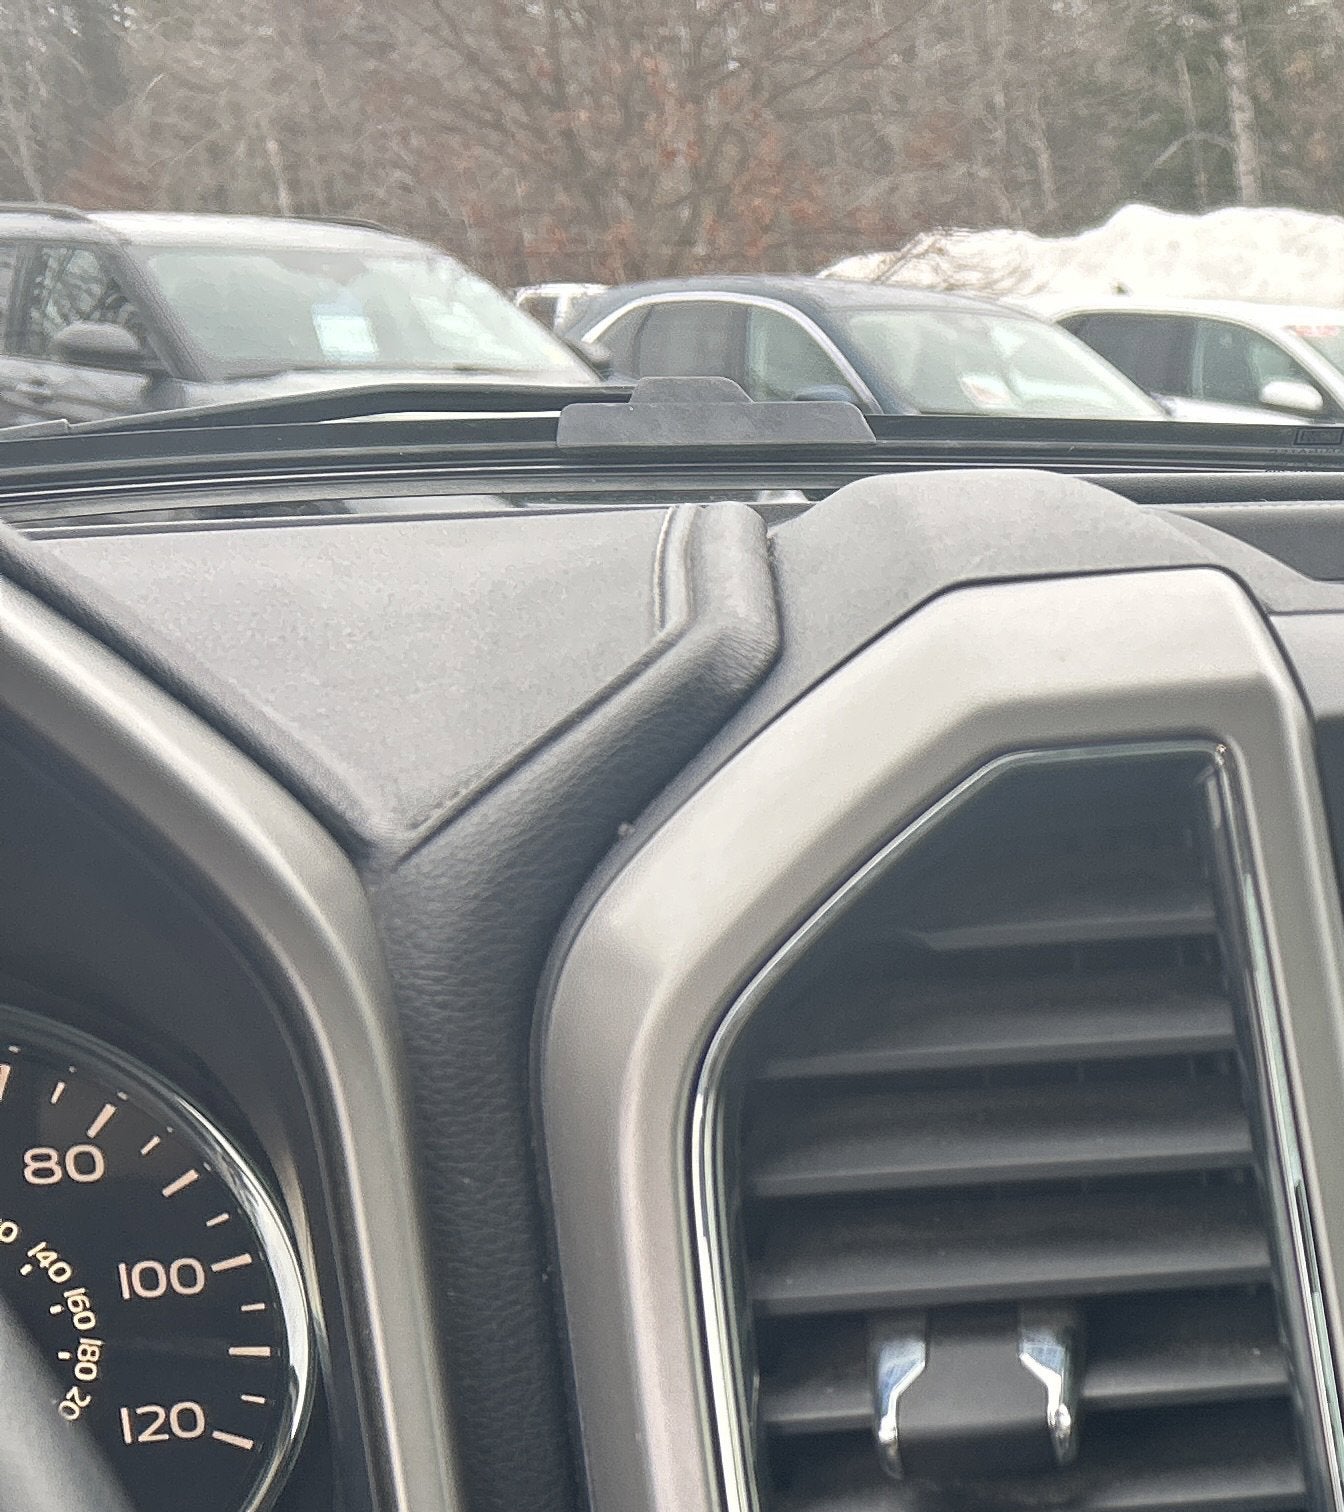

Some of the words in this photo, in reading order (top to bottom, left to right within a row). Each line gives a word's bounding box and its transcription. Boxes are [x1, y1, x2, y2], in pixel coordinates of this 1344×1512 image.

[23, 1145, 104, 1185] 80
[27, 1241, 73, 1283] 140
[118, 1257, 206, 1300] 100
[63, 1287, 96, 1331] 160
[74, 1337, 105, 1381] 180
[57, 1385, 92, 1421] 20
[120, 1401, 206, 1444] 120
